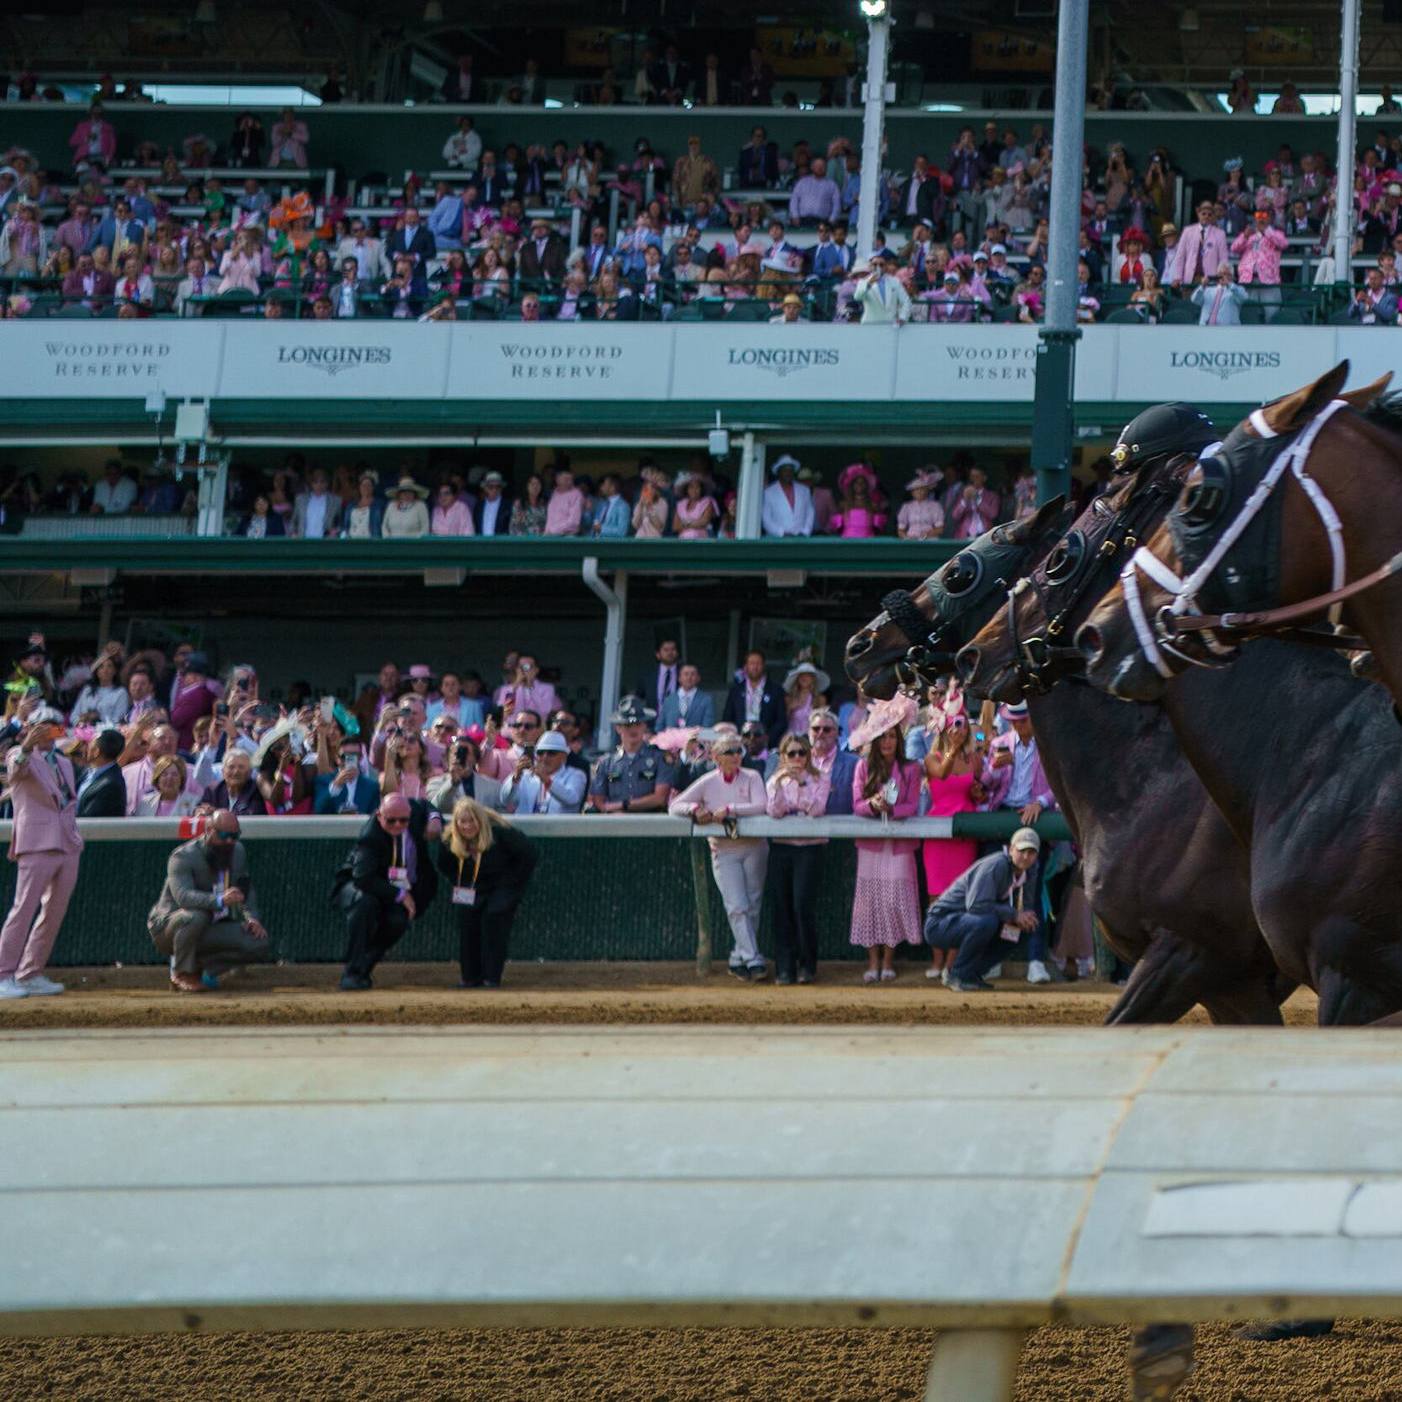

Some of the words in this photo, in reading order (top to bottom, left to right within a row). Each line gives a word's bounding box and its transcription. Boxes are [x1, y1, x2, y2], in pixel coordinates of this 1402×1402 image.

[45, 341, 171, 357] WOODFORD
[279, 347, 391, 363] LONGINES
[500, 344, 623, 359] WOODFORD
[946, 345, 1037, 360] WOODFO
[729, 349, 839, 365] LONGINES
[1171, 352, 1281, 367] LONGINES
[55, 362, 159, 376] RESERVE
[511, 364, 612, 378] RESERVE
[958, 365, 1036, 379] RESER
